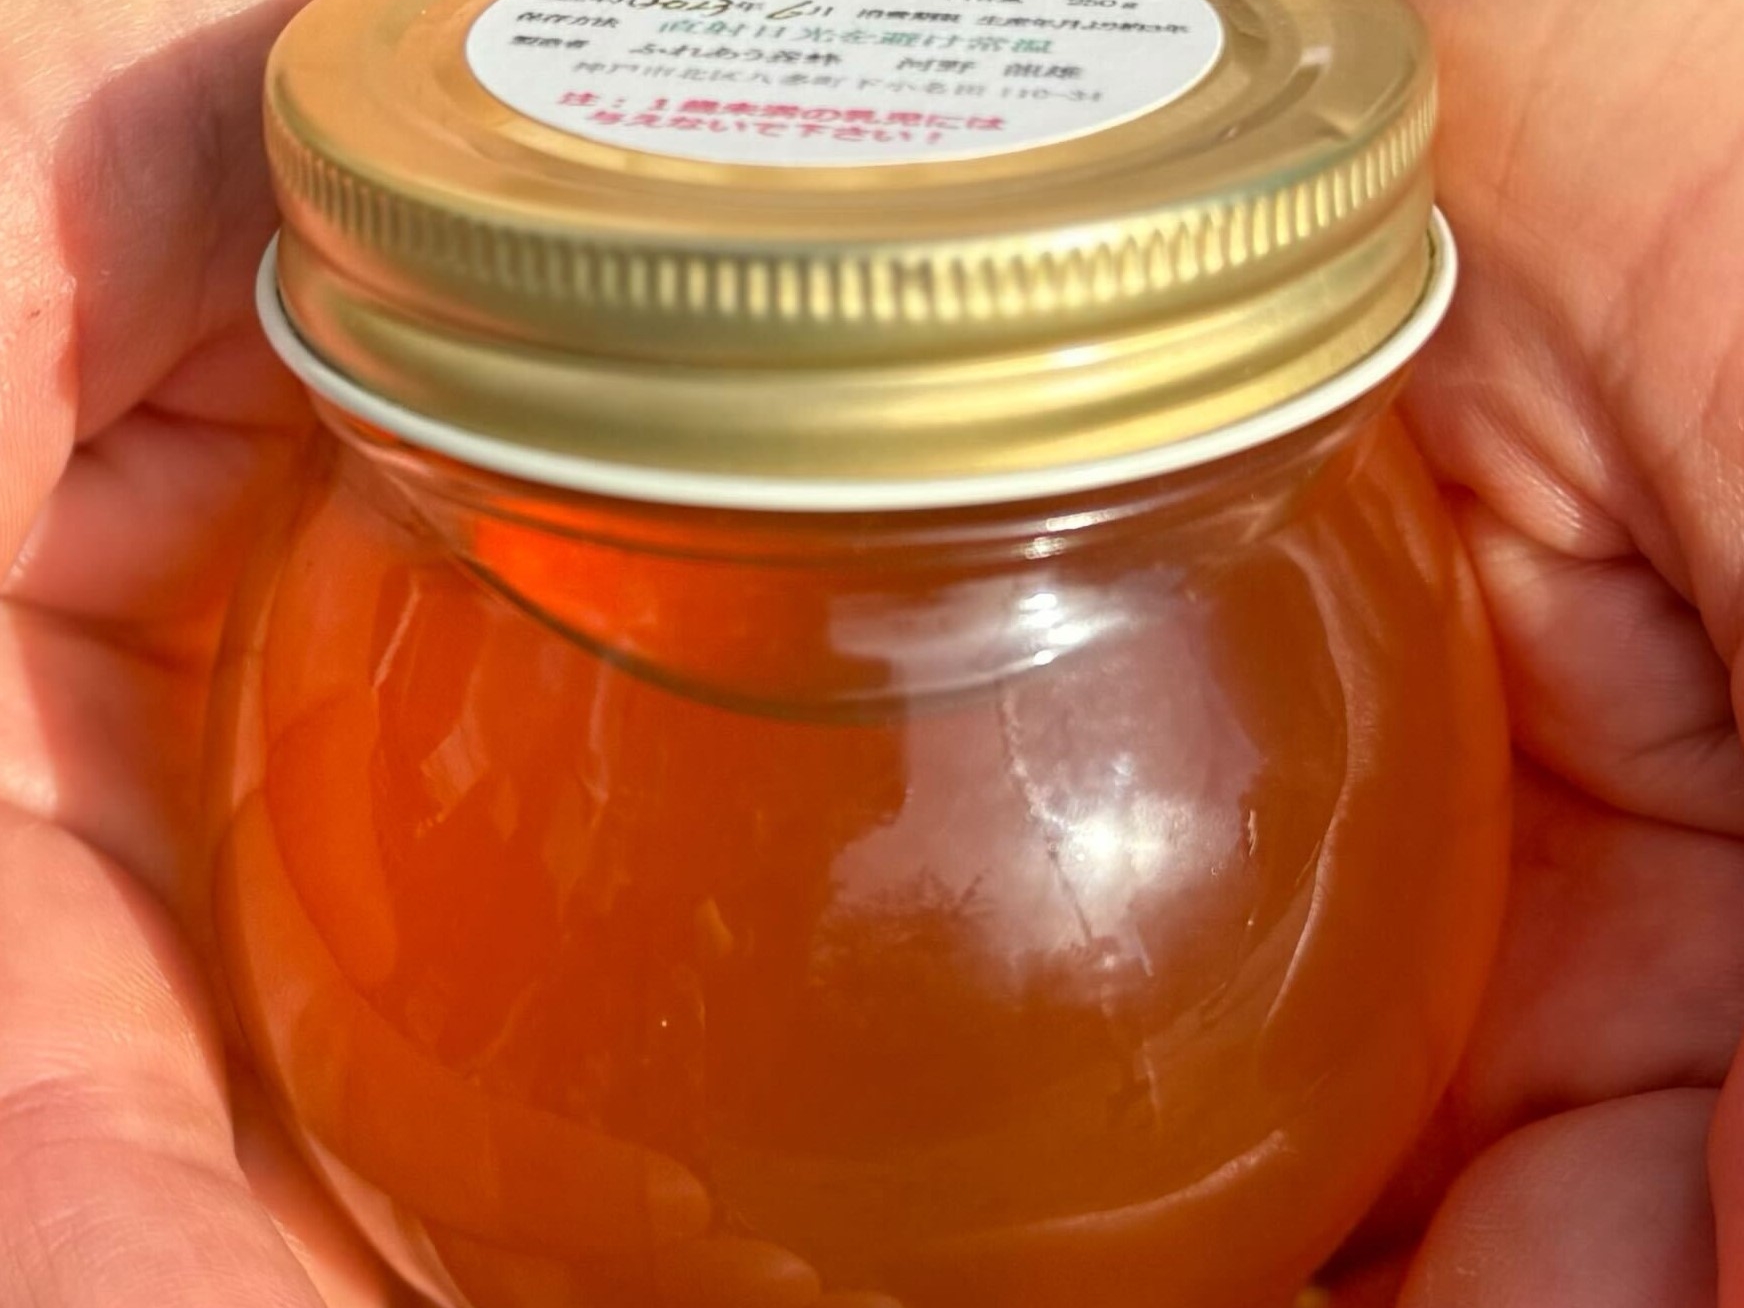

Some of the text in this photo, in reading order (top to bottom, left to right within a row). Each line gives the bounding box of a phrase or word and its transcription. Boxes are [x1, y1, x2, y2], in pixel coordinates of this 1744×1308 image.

[515, 12, 1054, 53] 保存方法 直射日光を避け常温
[858, 8, 961, 23] 消費期限
[509, 34, 591, 48] 製造者
[630, 43, 842, 66] ふれあう養蜂
[895, 56, 977, 74] 河野
